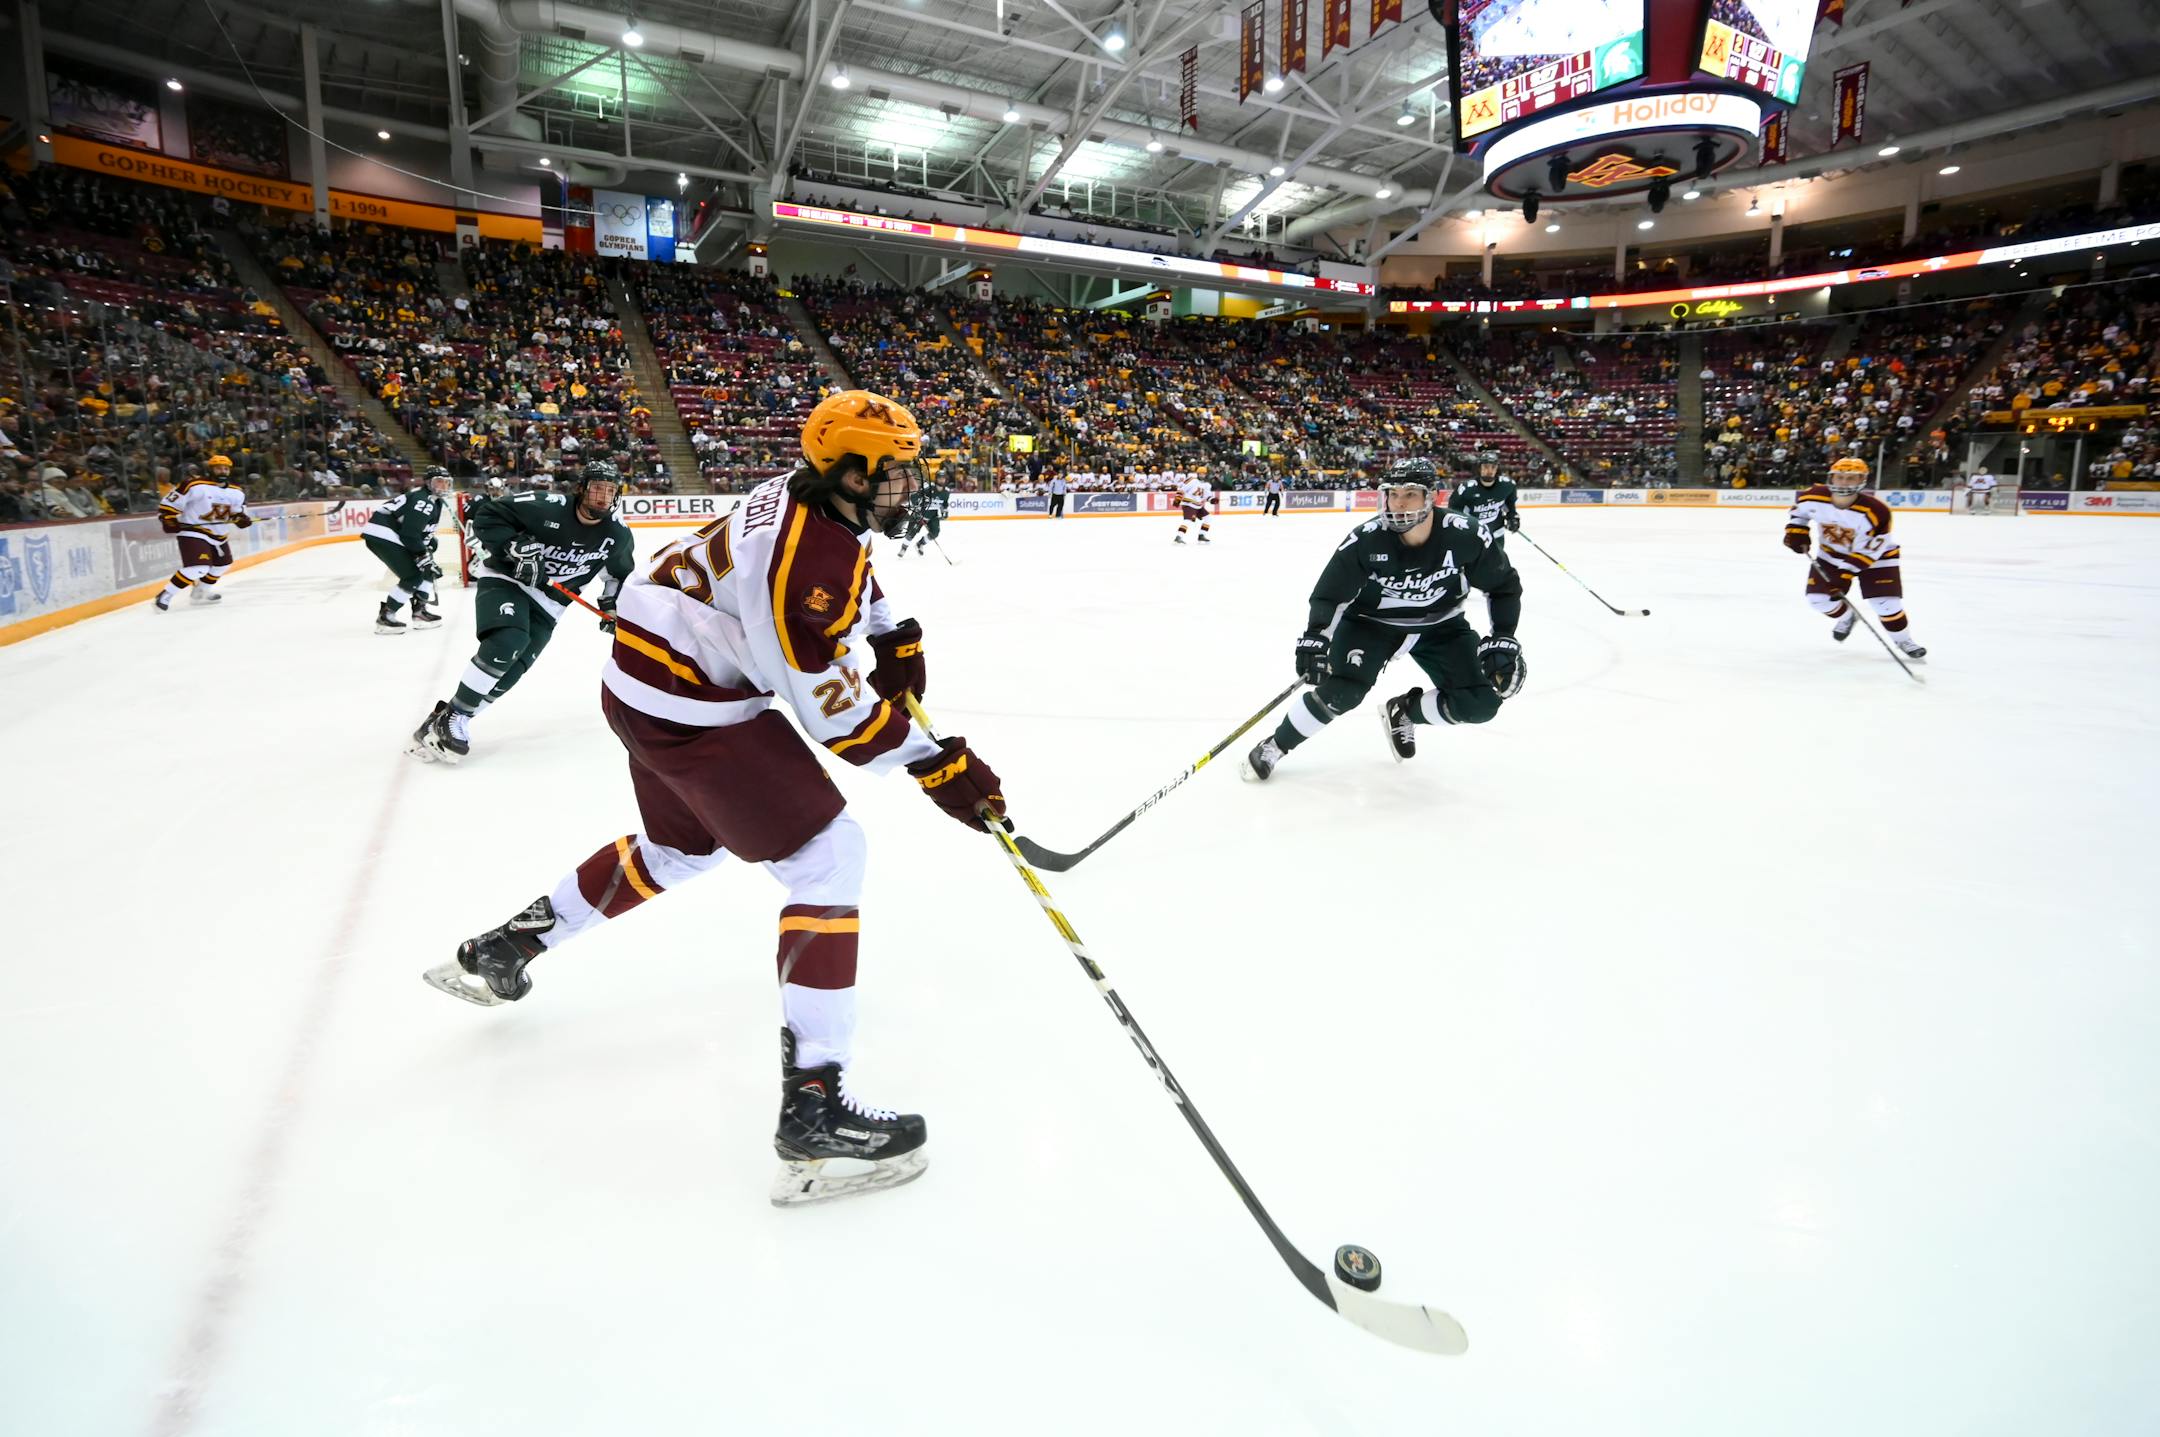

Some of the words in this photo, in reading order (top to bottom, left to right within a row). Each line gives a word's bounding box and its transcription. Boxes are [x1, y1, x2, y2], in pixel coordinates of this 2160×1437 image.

[1575, 53, 1585, 71] 1
[1505, 80, 1517, 98] 2
[1613, 93, 1719, 126] Holiday
[98, 151, 198, 185] GOPHER
[203, 173, 293, 202] HOCKEY
[301, 192, 388, 218] 11-1994
[599, 241, 645, 252] OLYMPIANS
[603, 234, 636, 244] GOPHER
[413, 500, 434, 516] 22
[622, 498, 715, 515] LOFFLER
[2040, 498, 2067, 507] PLUS
[2083, 496, 2112, 508] 3M
[540, 542, 609, 566] Michigan
[599, 537, 615, 554] C
[1442, 549, 1455, 568] A
[1368, 566, 1458, 593] Michigan
[1381, 586, 1448, 602] State
